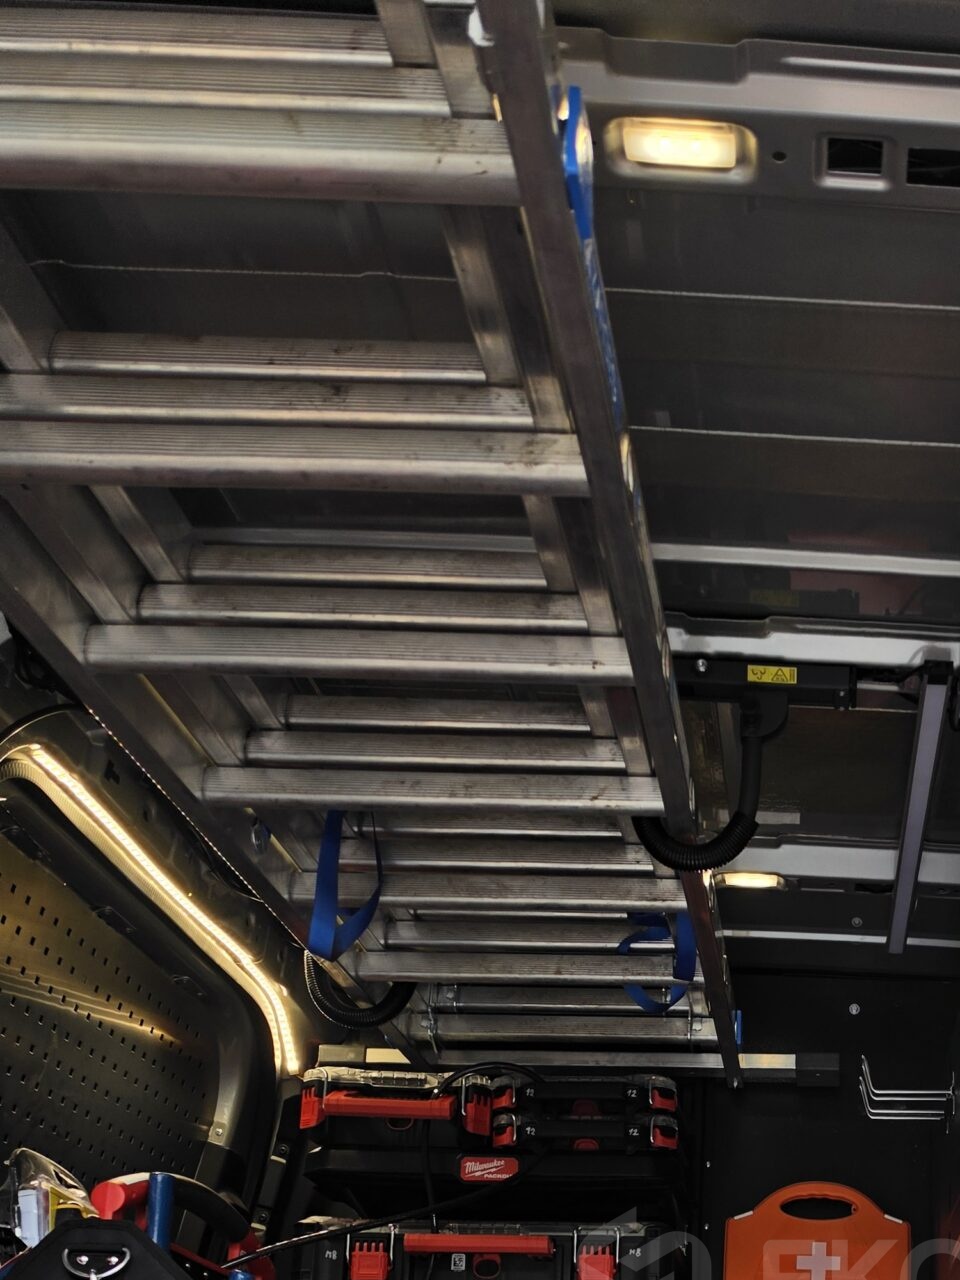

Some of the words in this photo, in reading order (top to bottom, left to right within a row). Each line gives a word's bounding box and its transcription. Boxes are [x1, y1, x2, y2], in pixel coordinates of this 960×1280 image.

[627, 1089, 638, 1098] 12
[628, 1127, 639, 1136] 12
[464, 1159, 505, 1175] Milwaukee
